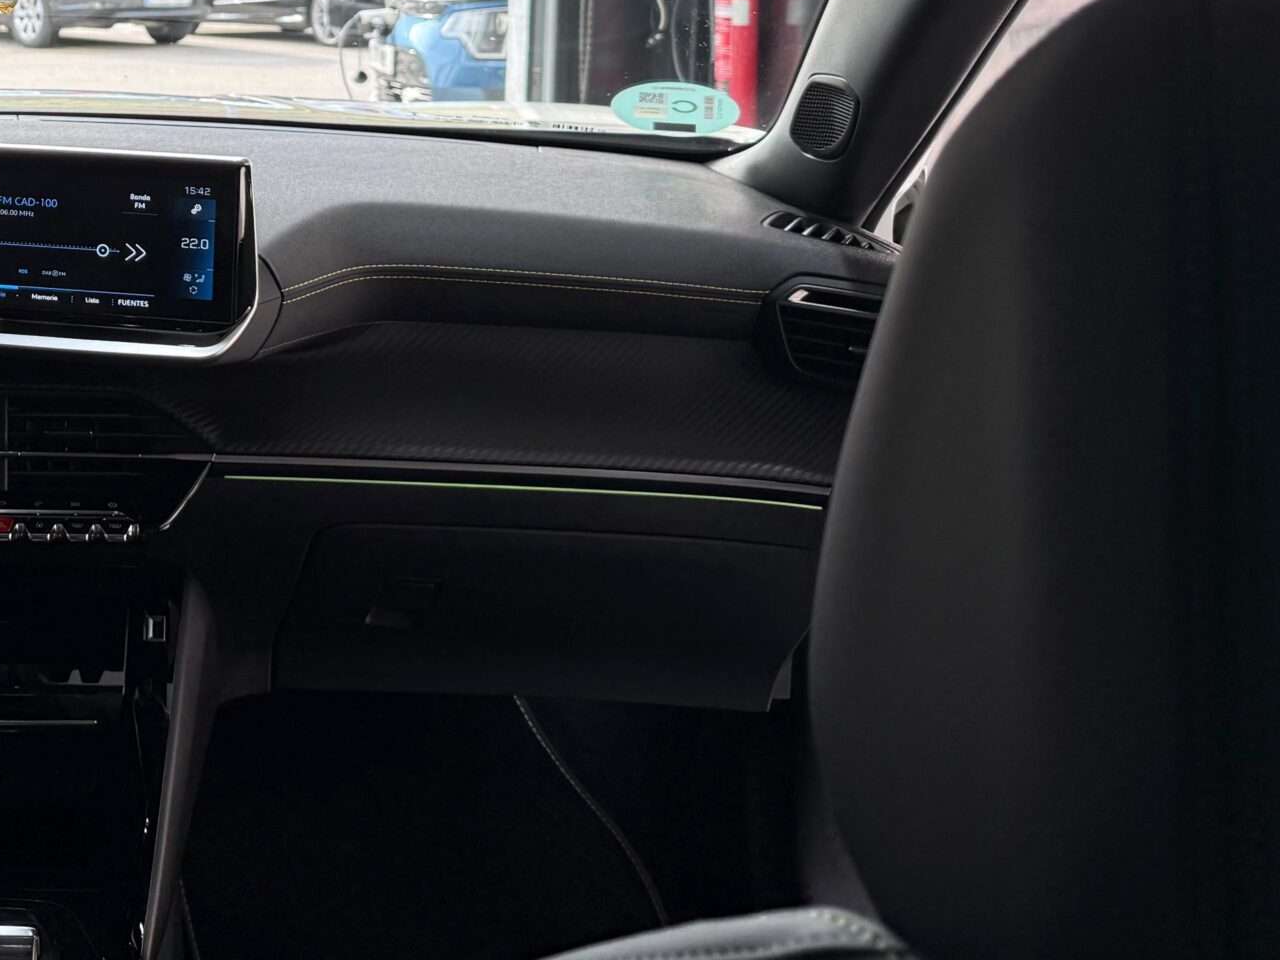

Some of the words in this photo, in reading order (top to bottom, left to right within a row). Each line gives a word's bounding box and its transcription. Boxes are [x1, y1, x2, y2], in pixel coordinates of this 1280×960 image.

[184, 186, 211, 196] 15:42
[129, 193, 151, 202] Banda
[14, 197, 58, 208] CAD-100
[134, 202, 146, 210] FM
[19, 209, 35, 218] MHz
[180, 237, 209, 250] 22.0
[31, 293, 58, 302] Memoria
[117, 299, 149, 308] FUENTES
